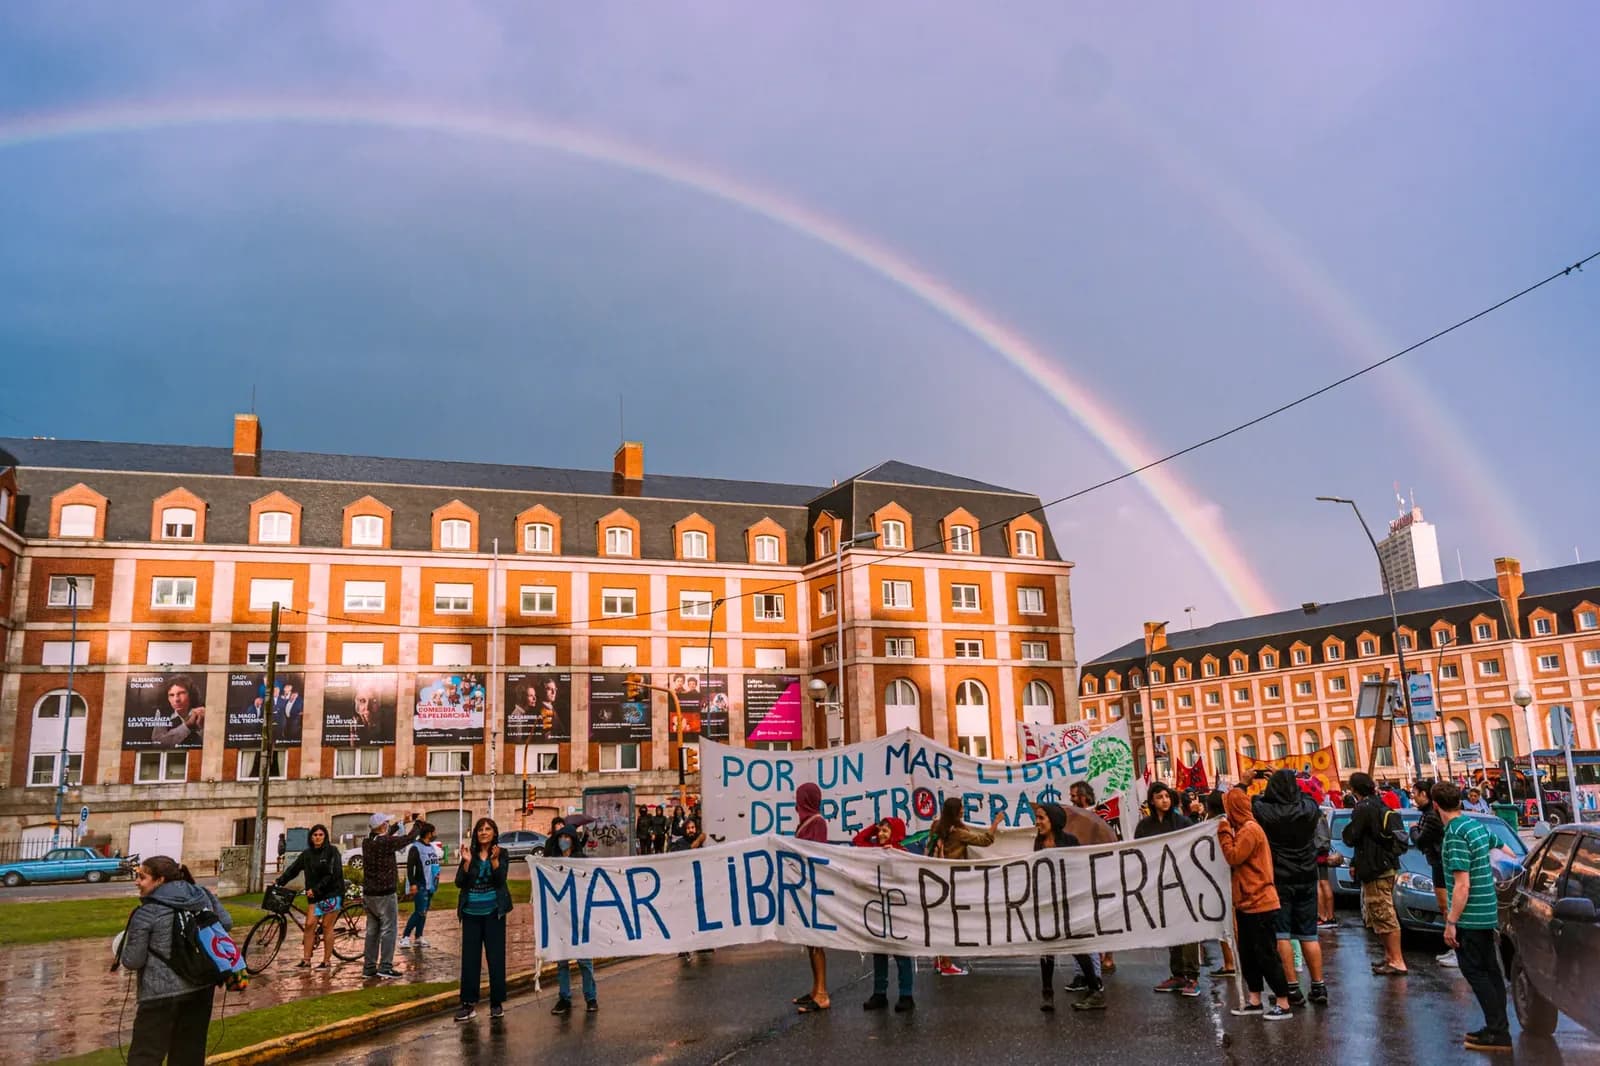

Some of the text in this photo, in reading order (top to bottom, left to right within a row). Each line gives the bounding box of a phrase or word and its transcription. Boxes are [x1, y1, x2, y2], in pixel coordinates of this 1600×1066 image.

[722, 743, 1088, 792] POR UN MAR LIBRE
[751, 801, 796, 836] DE
[535, 867, 672, 948] MAR
[863, 865, 908, 940] de
[918, 835, 1227, 948] PETROLERAS
